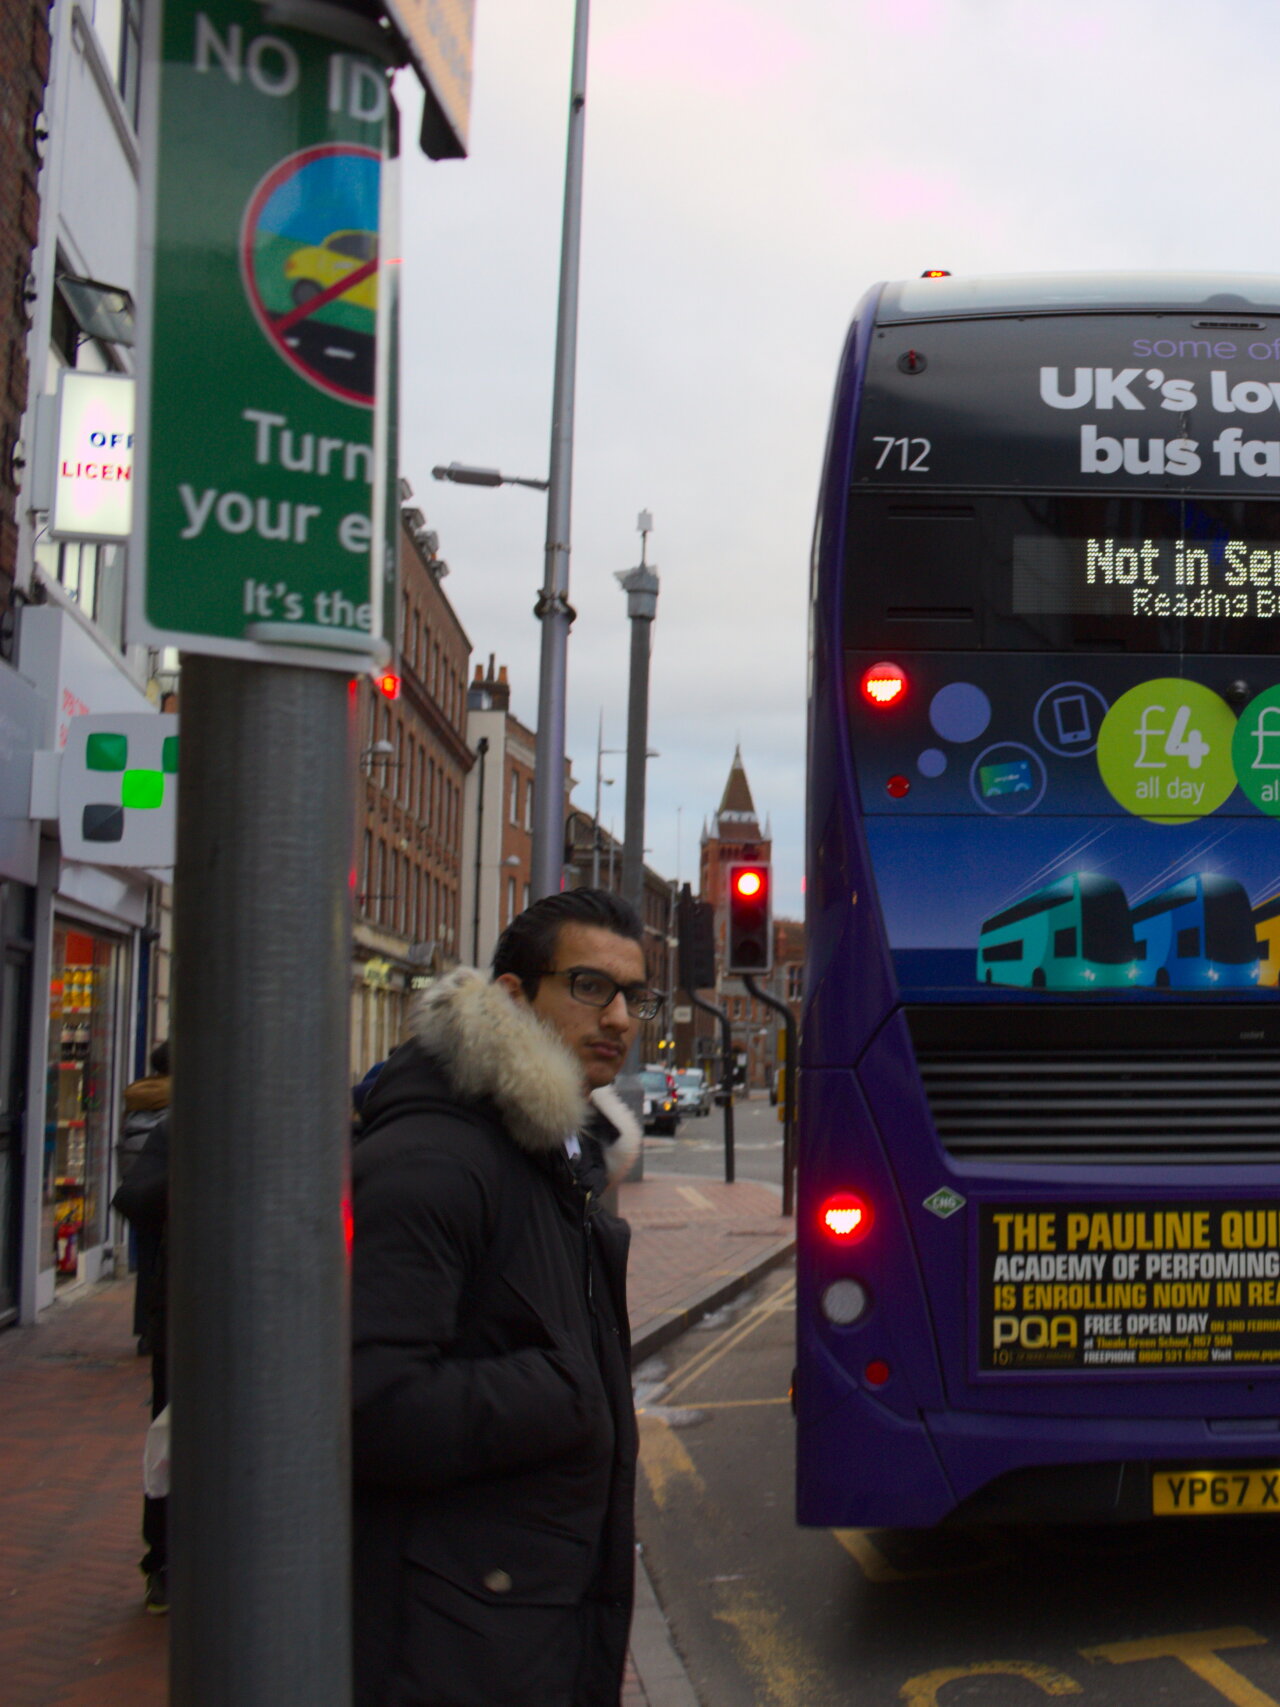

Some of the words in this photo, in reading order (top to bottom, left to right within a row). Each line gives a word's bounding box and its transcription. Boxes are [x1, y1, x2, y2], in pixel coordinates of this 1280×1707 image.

[195, 11, 299, 97] NO
[1133, 339, 1237, 362] some
[1039, 366, 1198, 412] UK's
[90, 432, 132, 448] OF
[242, 408, 375, 485] Turn
[872, 435, 932, 473] 712
[1080, 424, 1201, 477] bus
[178, 484, 322, 543] your
[1086, 538, 1160, 586] Not
[1174, 539, 1210, 588] in
[243, 578, 304, 622] It's
[1132, 588, 1248, 618] Reading
[1133, 704, 1211, 771] £4
[1135, 776, 1162, 800] all
[1165, 775, 1206, 805] day
[993, 1213, 1056, 1252] THE
[1067, 1211, 1210, 1251] PAULINE
[994, 1253, 1107, 1282] ACADEMY
[1112, 1253, 1140, 1281] OF
[1145, 1251, 1280, 1280] PERFOMING
[994, 1284, 1016, 1311] IS
[1023, 1282, 1147, 1311] ENROLLING
[1153, 1281, 1210, 1309] NOW
[1216, 1281, 1241, 1307] IN
[993, 1315, 1078, 1350] PQA
[1083, 1314, 1123, 1336] FREE
[1127, 1313, 1172, 1335] OPEN
[1176, 1312, 1209, 1334] DAY
[1083, 1349, 1136, 1364] FREEPHONE
[1211, 1348, 1232, 1361] Visit
[1166, 1475, 1250, 1508] YP67
